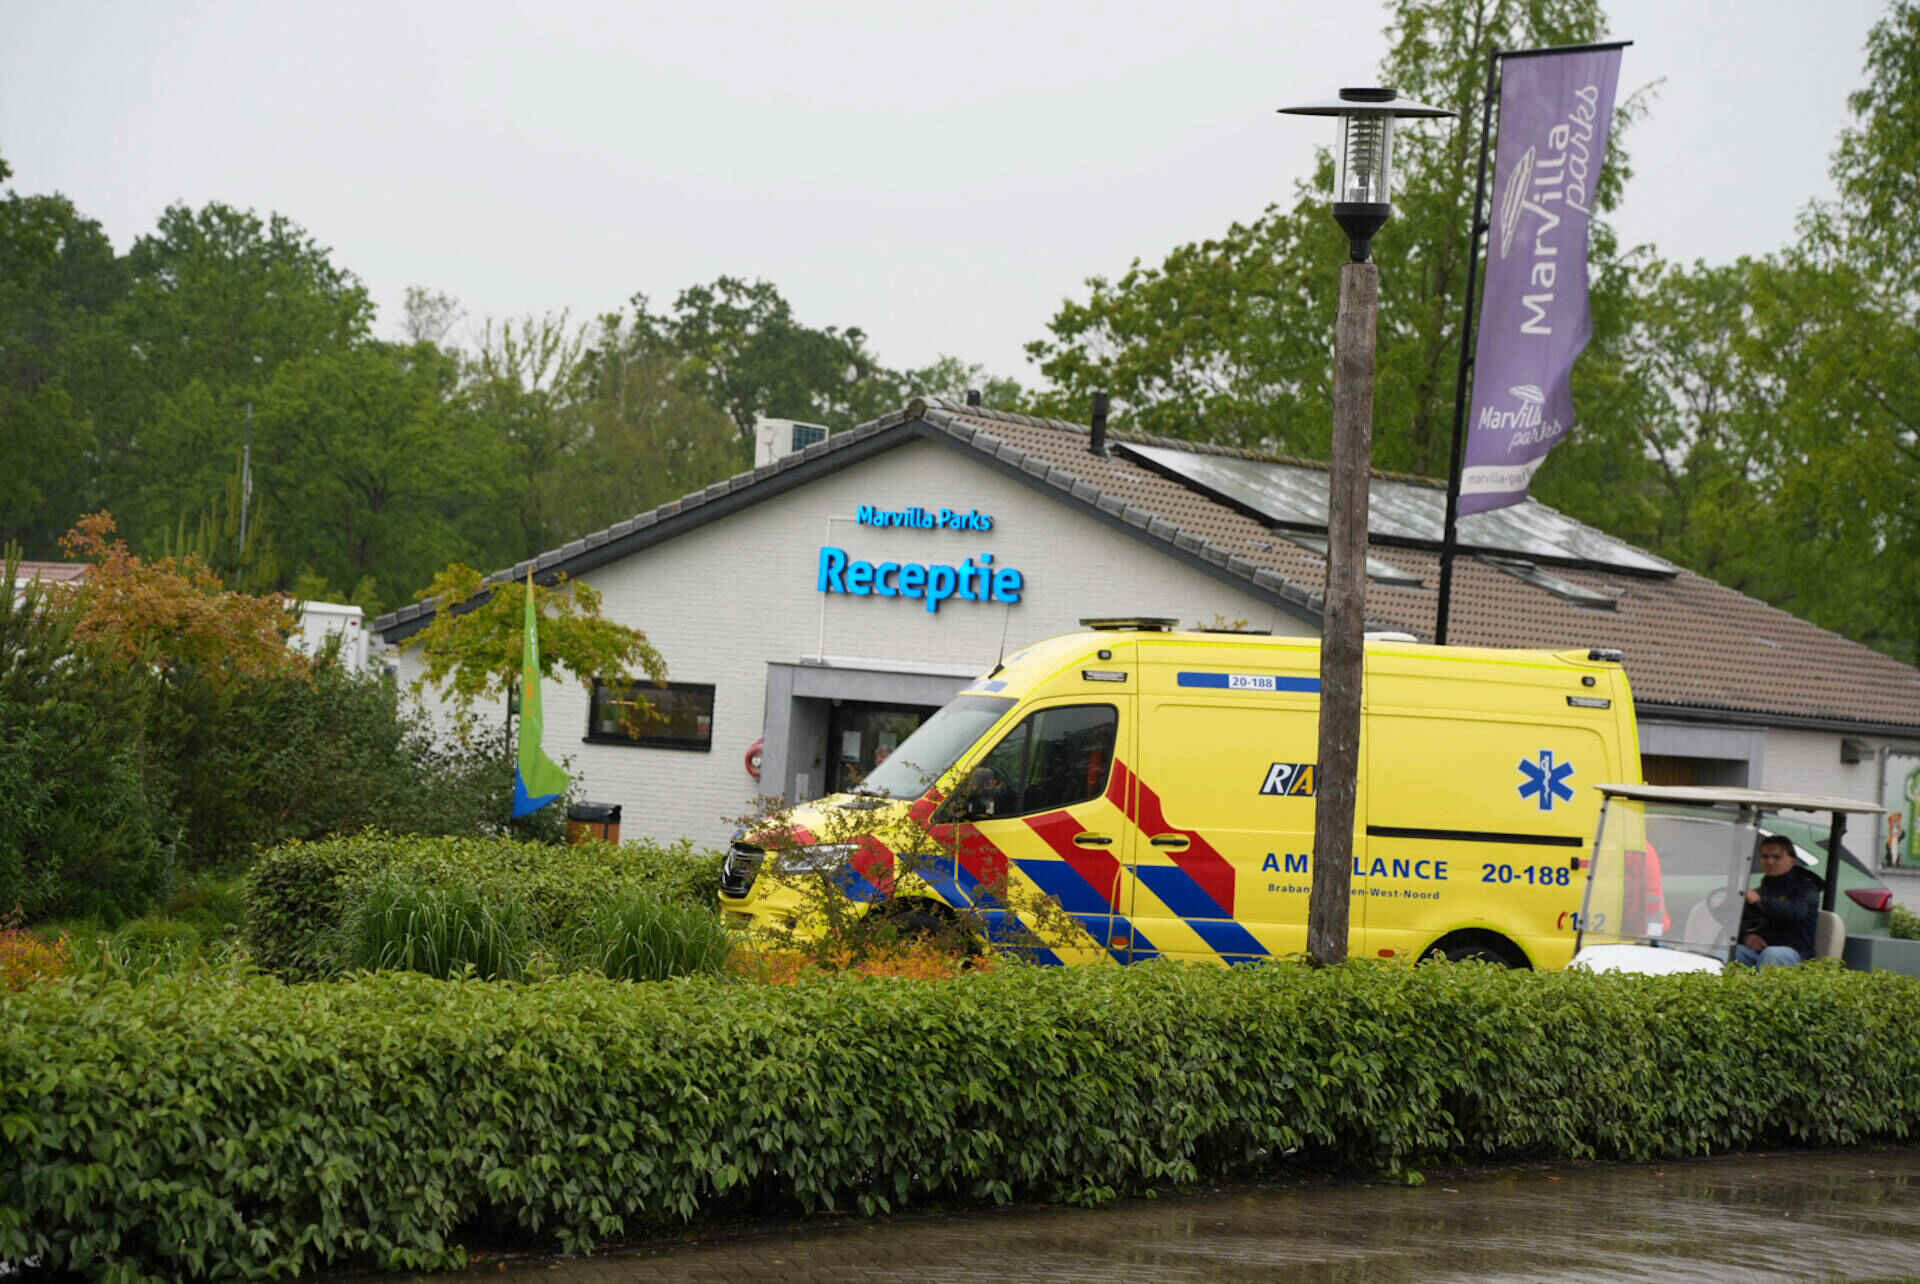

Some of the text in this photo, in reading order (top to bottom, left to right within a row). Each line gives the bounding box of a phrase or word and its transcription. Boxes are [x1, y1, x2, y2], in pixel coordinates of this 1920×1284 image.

[1565, 85, 1598, 217] parks
[856, 504, 993, 531] Marvilla Parks
[817, 546, 1022, 613] Receptie
[1232, 676, 1273, 688] 20-188
[1262, 853, 1449, 880] AMLANCE
[1481, 863, 1570, 886] 20-188
[1268, 883, 1310, 894] Braban
[1569, 911, 1606, 933] 12
